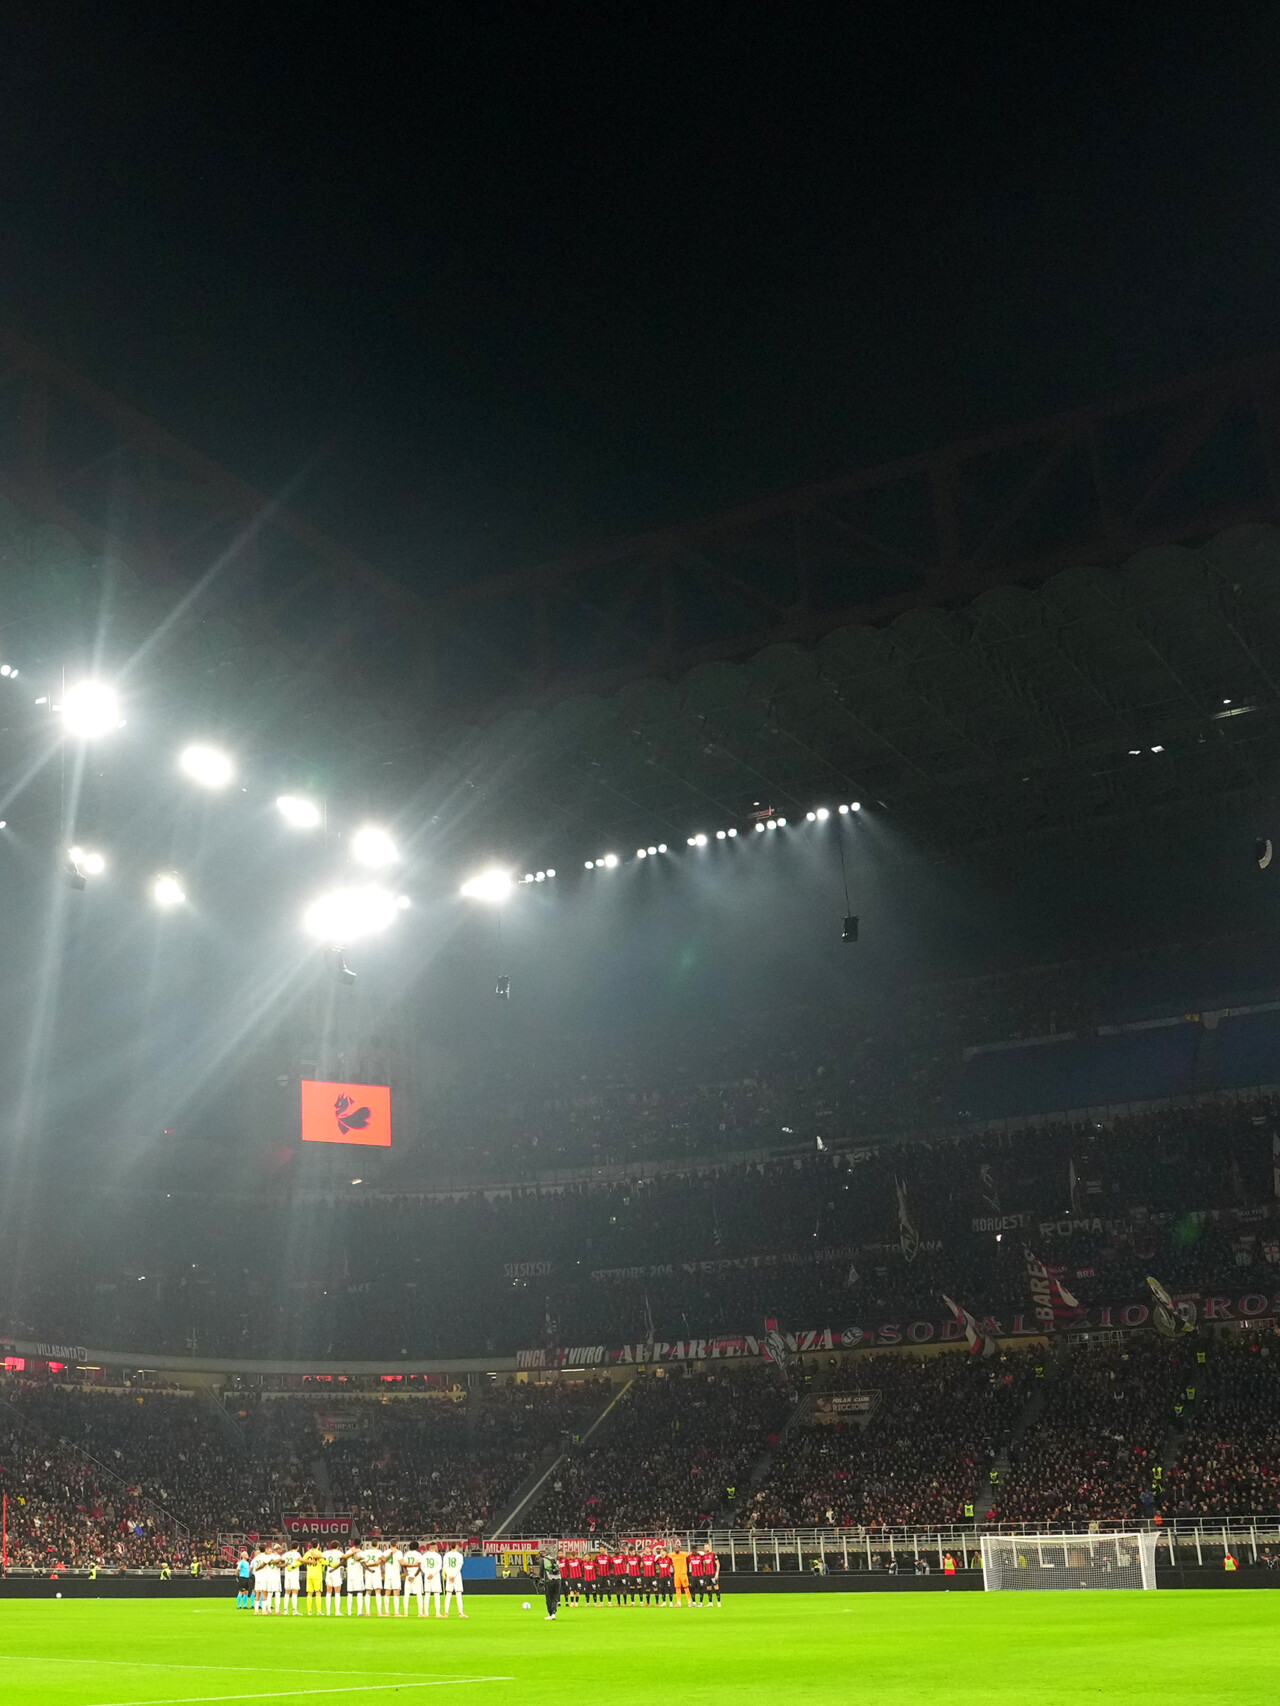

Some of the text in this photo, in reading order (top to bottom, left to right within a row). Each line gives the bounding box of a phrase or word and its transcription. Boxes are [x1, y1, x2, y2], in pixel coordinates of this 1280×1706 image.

[1039, 1217, 1103, 1239] ROMA
[883, 1239, 943, 1254] TOANA
[36, 1343, 78, 1361] VILLASANTA
[291, 1522, 349, 1534] CARUGO
[486, 1543, 510, 1556] MILAN
[558, 1541, 599, 1553] FEMMINILE
[426, 1557, 435, 1569] 19
[448, 1557, 457, 1568] 18
